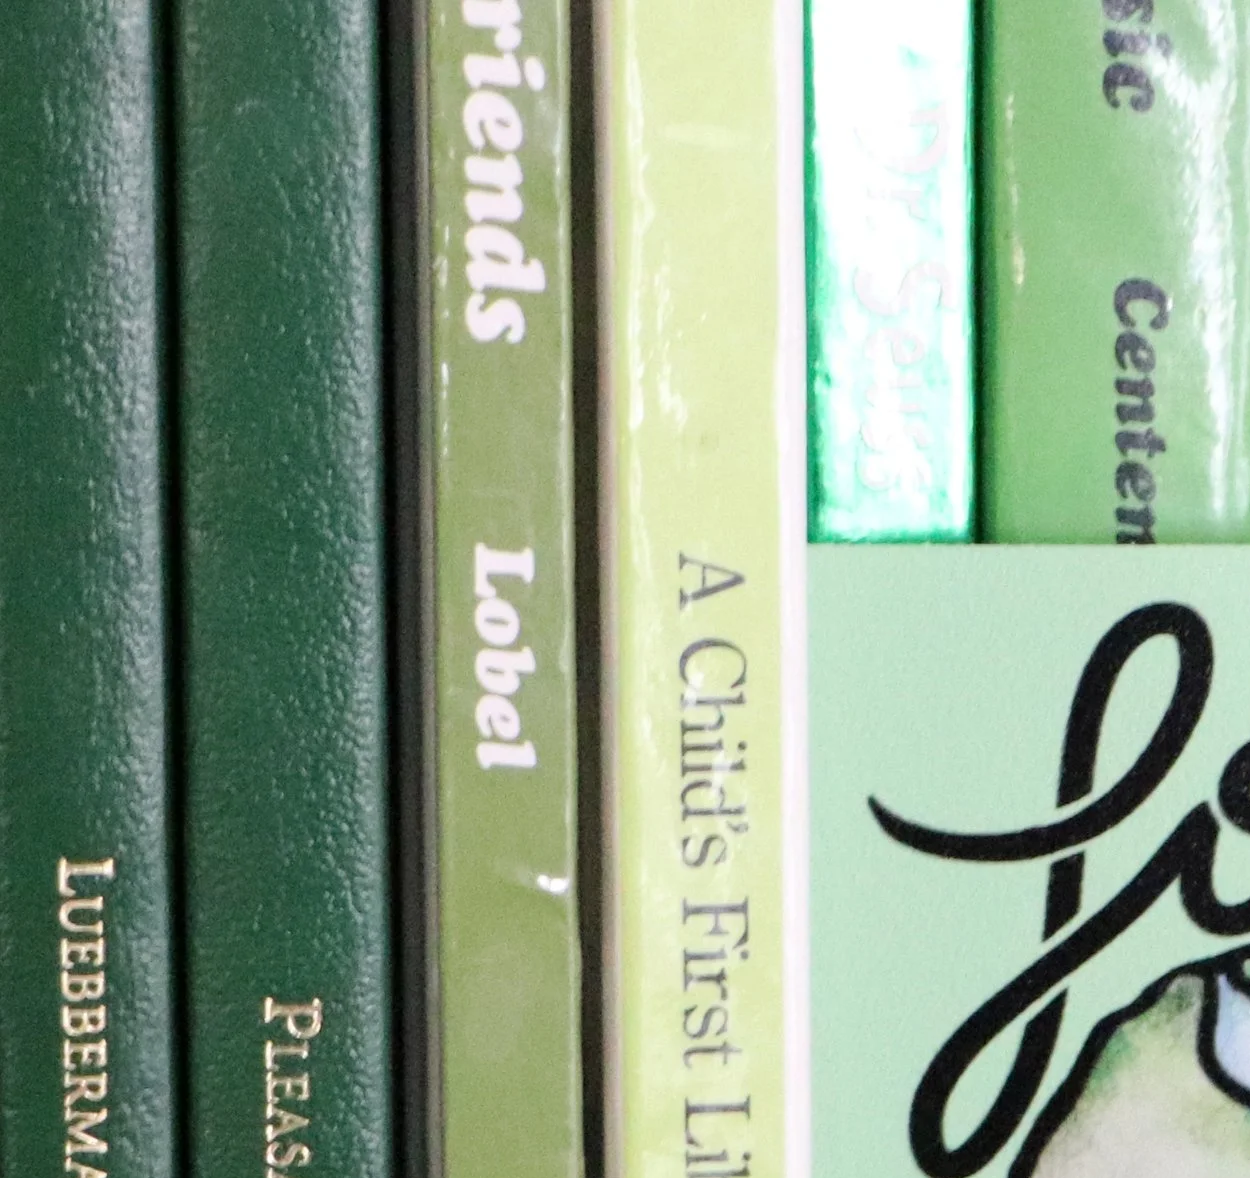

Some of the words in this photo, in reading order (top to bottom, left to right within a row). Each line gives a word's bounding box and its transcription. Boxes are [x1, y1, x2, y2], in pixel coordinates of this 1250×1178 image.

[463, 0, 545, 343] riends
[475, 543, 536, 771] Lobel
[679, 552, 746, 610] A
[679, 637, 749, 869] Child's
[682, 897, 750, 1069] First
